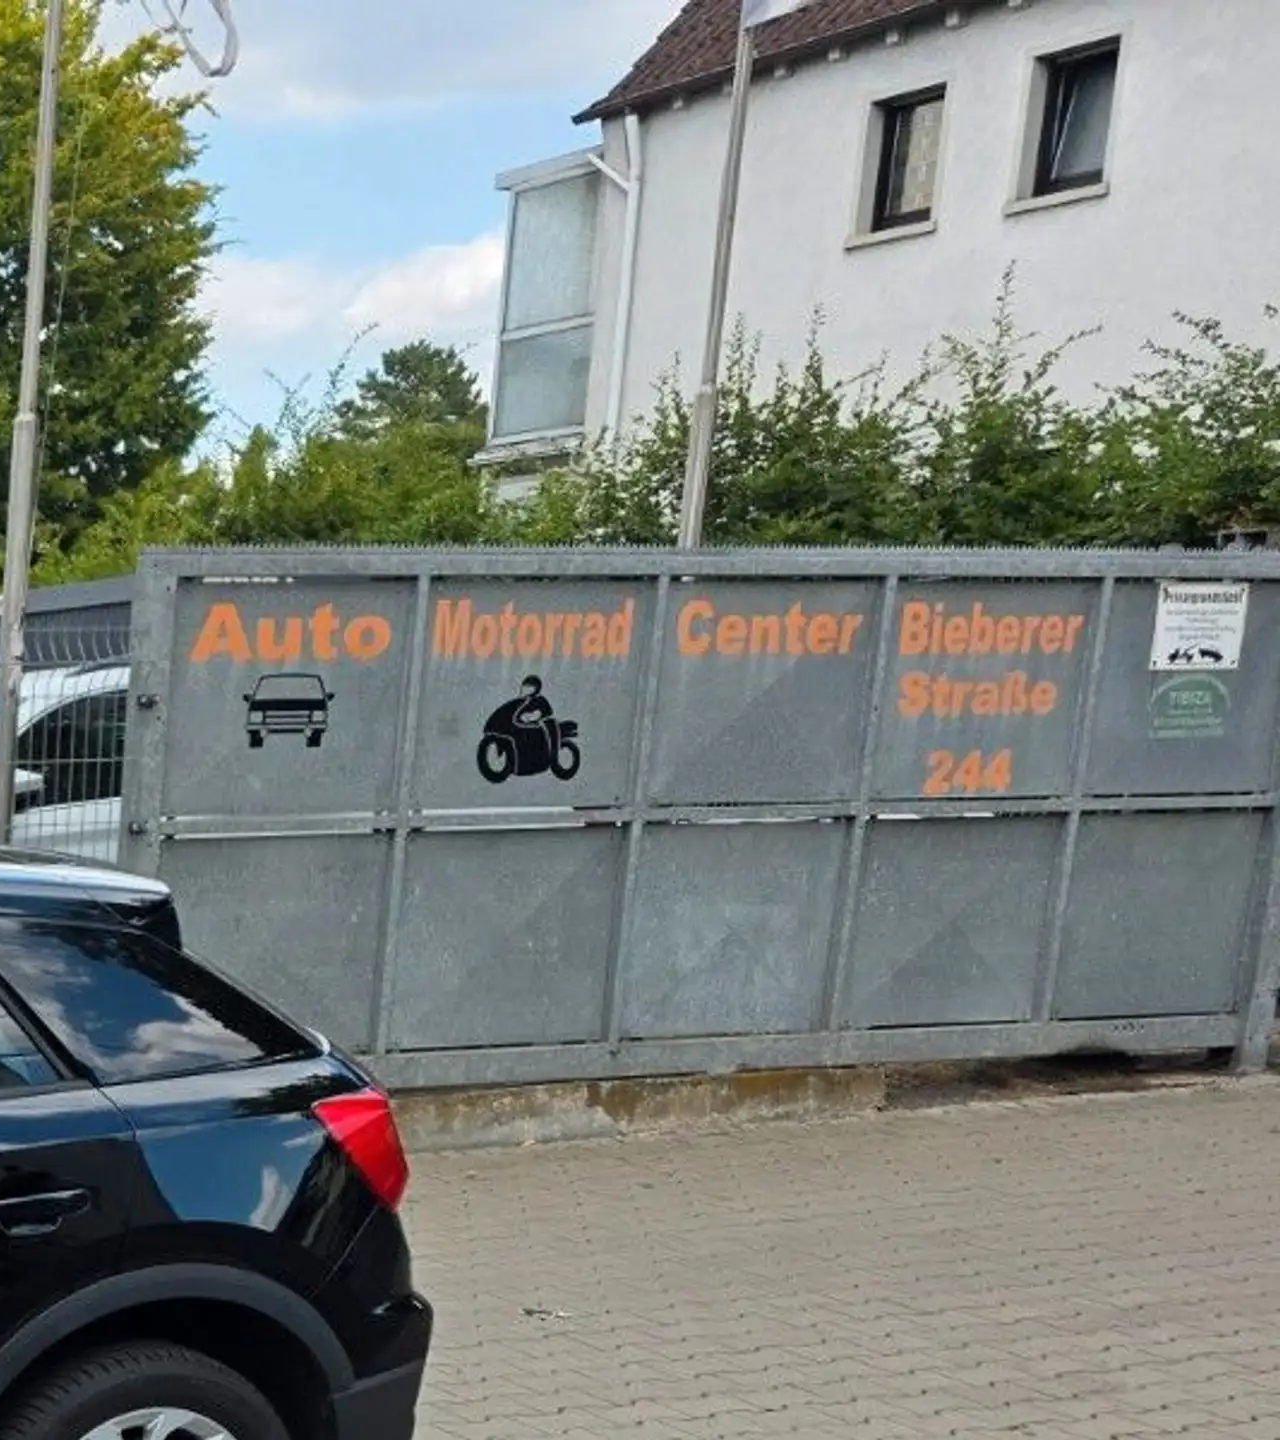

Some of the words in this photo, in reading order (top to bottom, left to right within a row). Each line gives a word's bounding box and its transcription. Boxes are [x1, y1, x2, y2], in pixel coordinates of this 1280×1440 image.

[189, 602, 393, 662] Auto
[433, 597, 636, 658] Motorrad
[676, 595, 864, 657] Center
[897, 600, 1085, 656] Bieberer
[896, 671, 1058, 718] Straße
[922, 748, 1014, 796] 244
